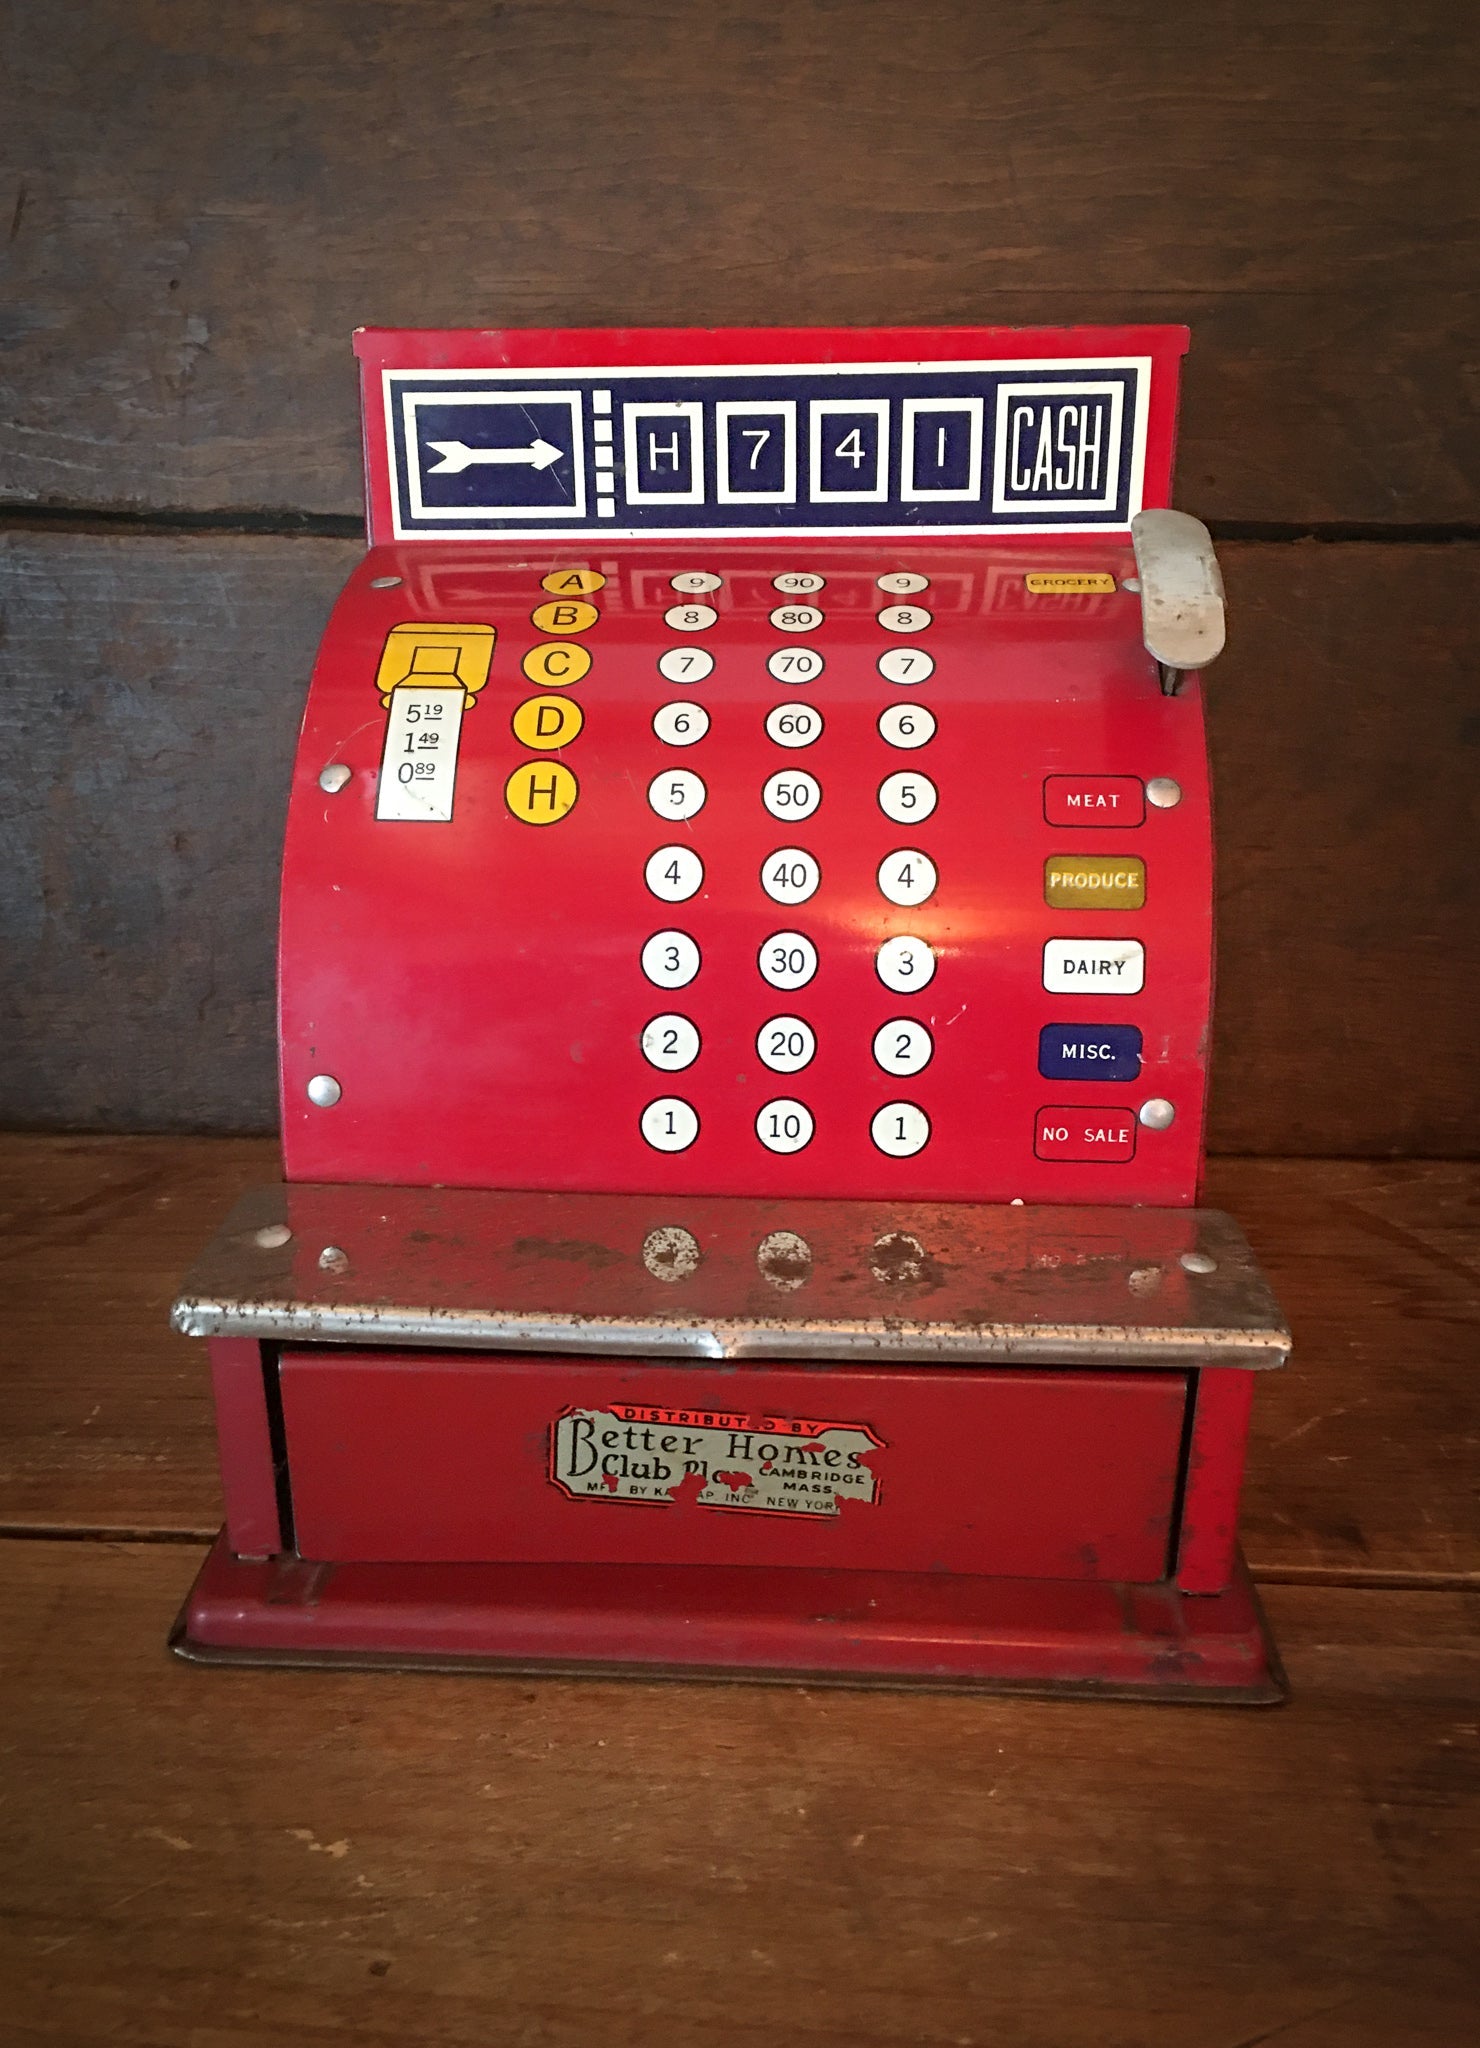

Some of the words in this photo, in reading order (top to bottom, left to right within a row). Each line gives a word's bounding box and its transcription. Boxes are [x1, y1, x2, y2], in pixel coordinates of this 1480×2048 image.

[648, 432, 680, 471] H
[741, 429, 771, 470] 7
[834, 428, 866, 469] 4
[1010, 404, 1104, 492] CASH
[557, 572, 585, 591] A
[688, 577, 706, 589] 9
[783, 576, 816, 589] 90
[895, 576, 912, 589] 9
[1030, 578, 1110, 587] GROCERY
[552, 607, 578, 626] B
[683, 611, 699, 624] 8
[781, 611, 813, 625] 80
[897, 611, 913, 625] 8
[543, 653, 571, 677] C
[680, 657, 695, 673] 7
[781, 656, 813, 673] 70
[900, 658, 915, 675] 7
[536, 705, 565, 737] D
[674, 713, 690, 733] 6
[778, 714, 812, 735] 60
[898, 715, 915, 735] 6
[528, 774, 558, 810] H
[670, 783, 685, 806] 5
[776, 783, 809, 807] 50
[901, 785, 917, 809] 5
[1066, 793, 1121, 809] MEAT
[664, 860, 681, 885] 4
[772, 863, 807, 888] 40
[897, 863, 915, 889] 4
[1050, 870, 1140, 890] PRODUCE
[664, 946, 680, 972] 3
[771, 947, 805, 974] 30
[898, 954, 914, 976] 3
[1062, 958, 1127, 977] DAIRY
[662, 1029, 678, 1054] 2
[770, 1031, 805, 1057] 20
[895, 1034, 911, 1059] 2
[1061, 1042, 1117, 1061] MISC.
[665, 1111, 677, 1135] 1
[769, 1114, 801, 1139] 10
[895, 1116, 907, 1141] 1
[1042, 1126, 1069, 1143] NO
[1083, 1127, 1130, 1145] SALE
[624, 1408, 776, 1431] DISTRIBUTD
[791, 1422, 819, 1434] BY
[566, 1418, 703, 1477] Better
[726, 1433, 863, 1470] Homes
[602, 1454, 672, 1481] Club
[758, 1467, 866, 1485] CAMBRIDGE
[630, 1485, 648, 1495] BY
[767, 1497, 799, 1508] NEW
